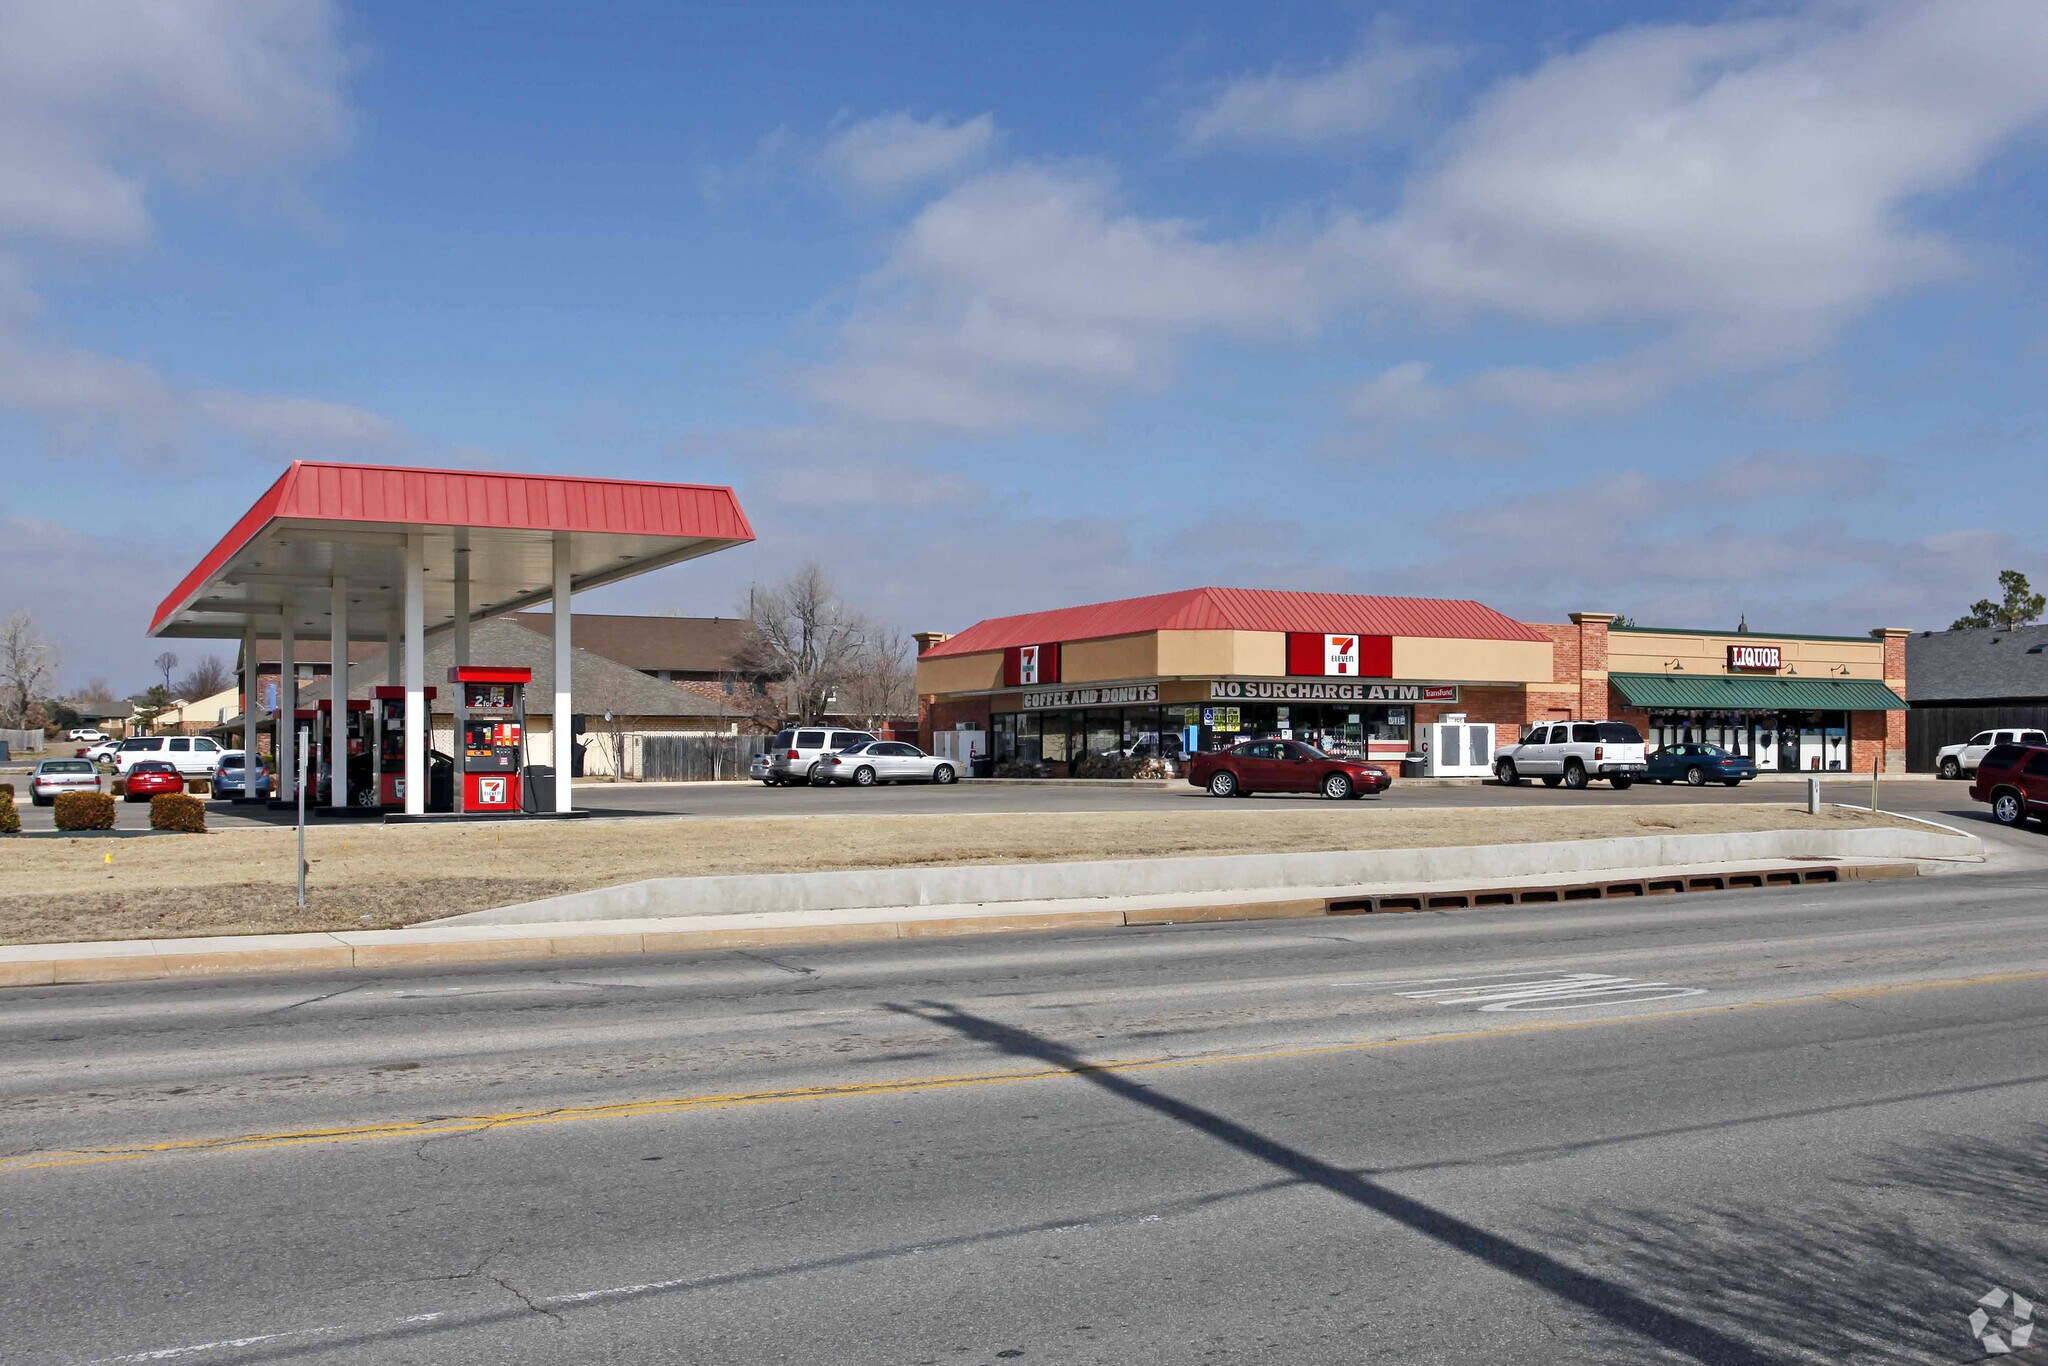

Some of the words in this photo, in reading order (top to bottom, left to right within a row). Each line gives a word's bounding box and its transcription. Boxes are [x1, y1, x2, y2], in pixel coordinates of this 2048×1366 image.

[1332, 637, 1354, 673] 7
[1732, 647, 1780, 667] LIQUOR
[1023, 649, 1034, 682] 7
[1024, 692, 1068, 707] COFFEE
[1071, 689, 1098, 704] AND
[1101, 685, 1157, 703] DONUTS
[1212, 681, 1241, 697] NO
[1245, 682, 1363, 699] SURCHARGE
[1368, 685, 1419, 700] ATM
[474, 695, 483, 707] 2
[485, 782, 500, 801] 7
